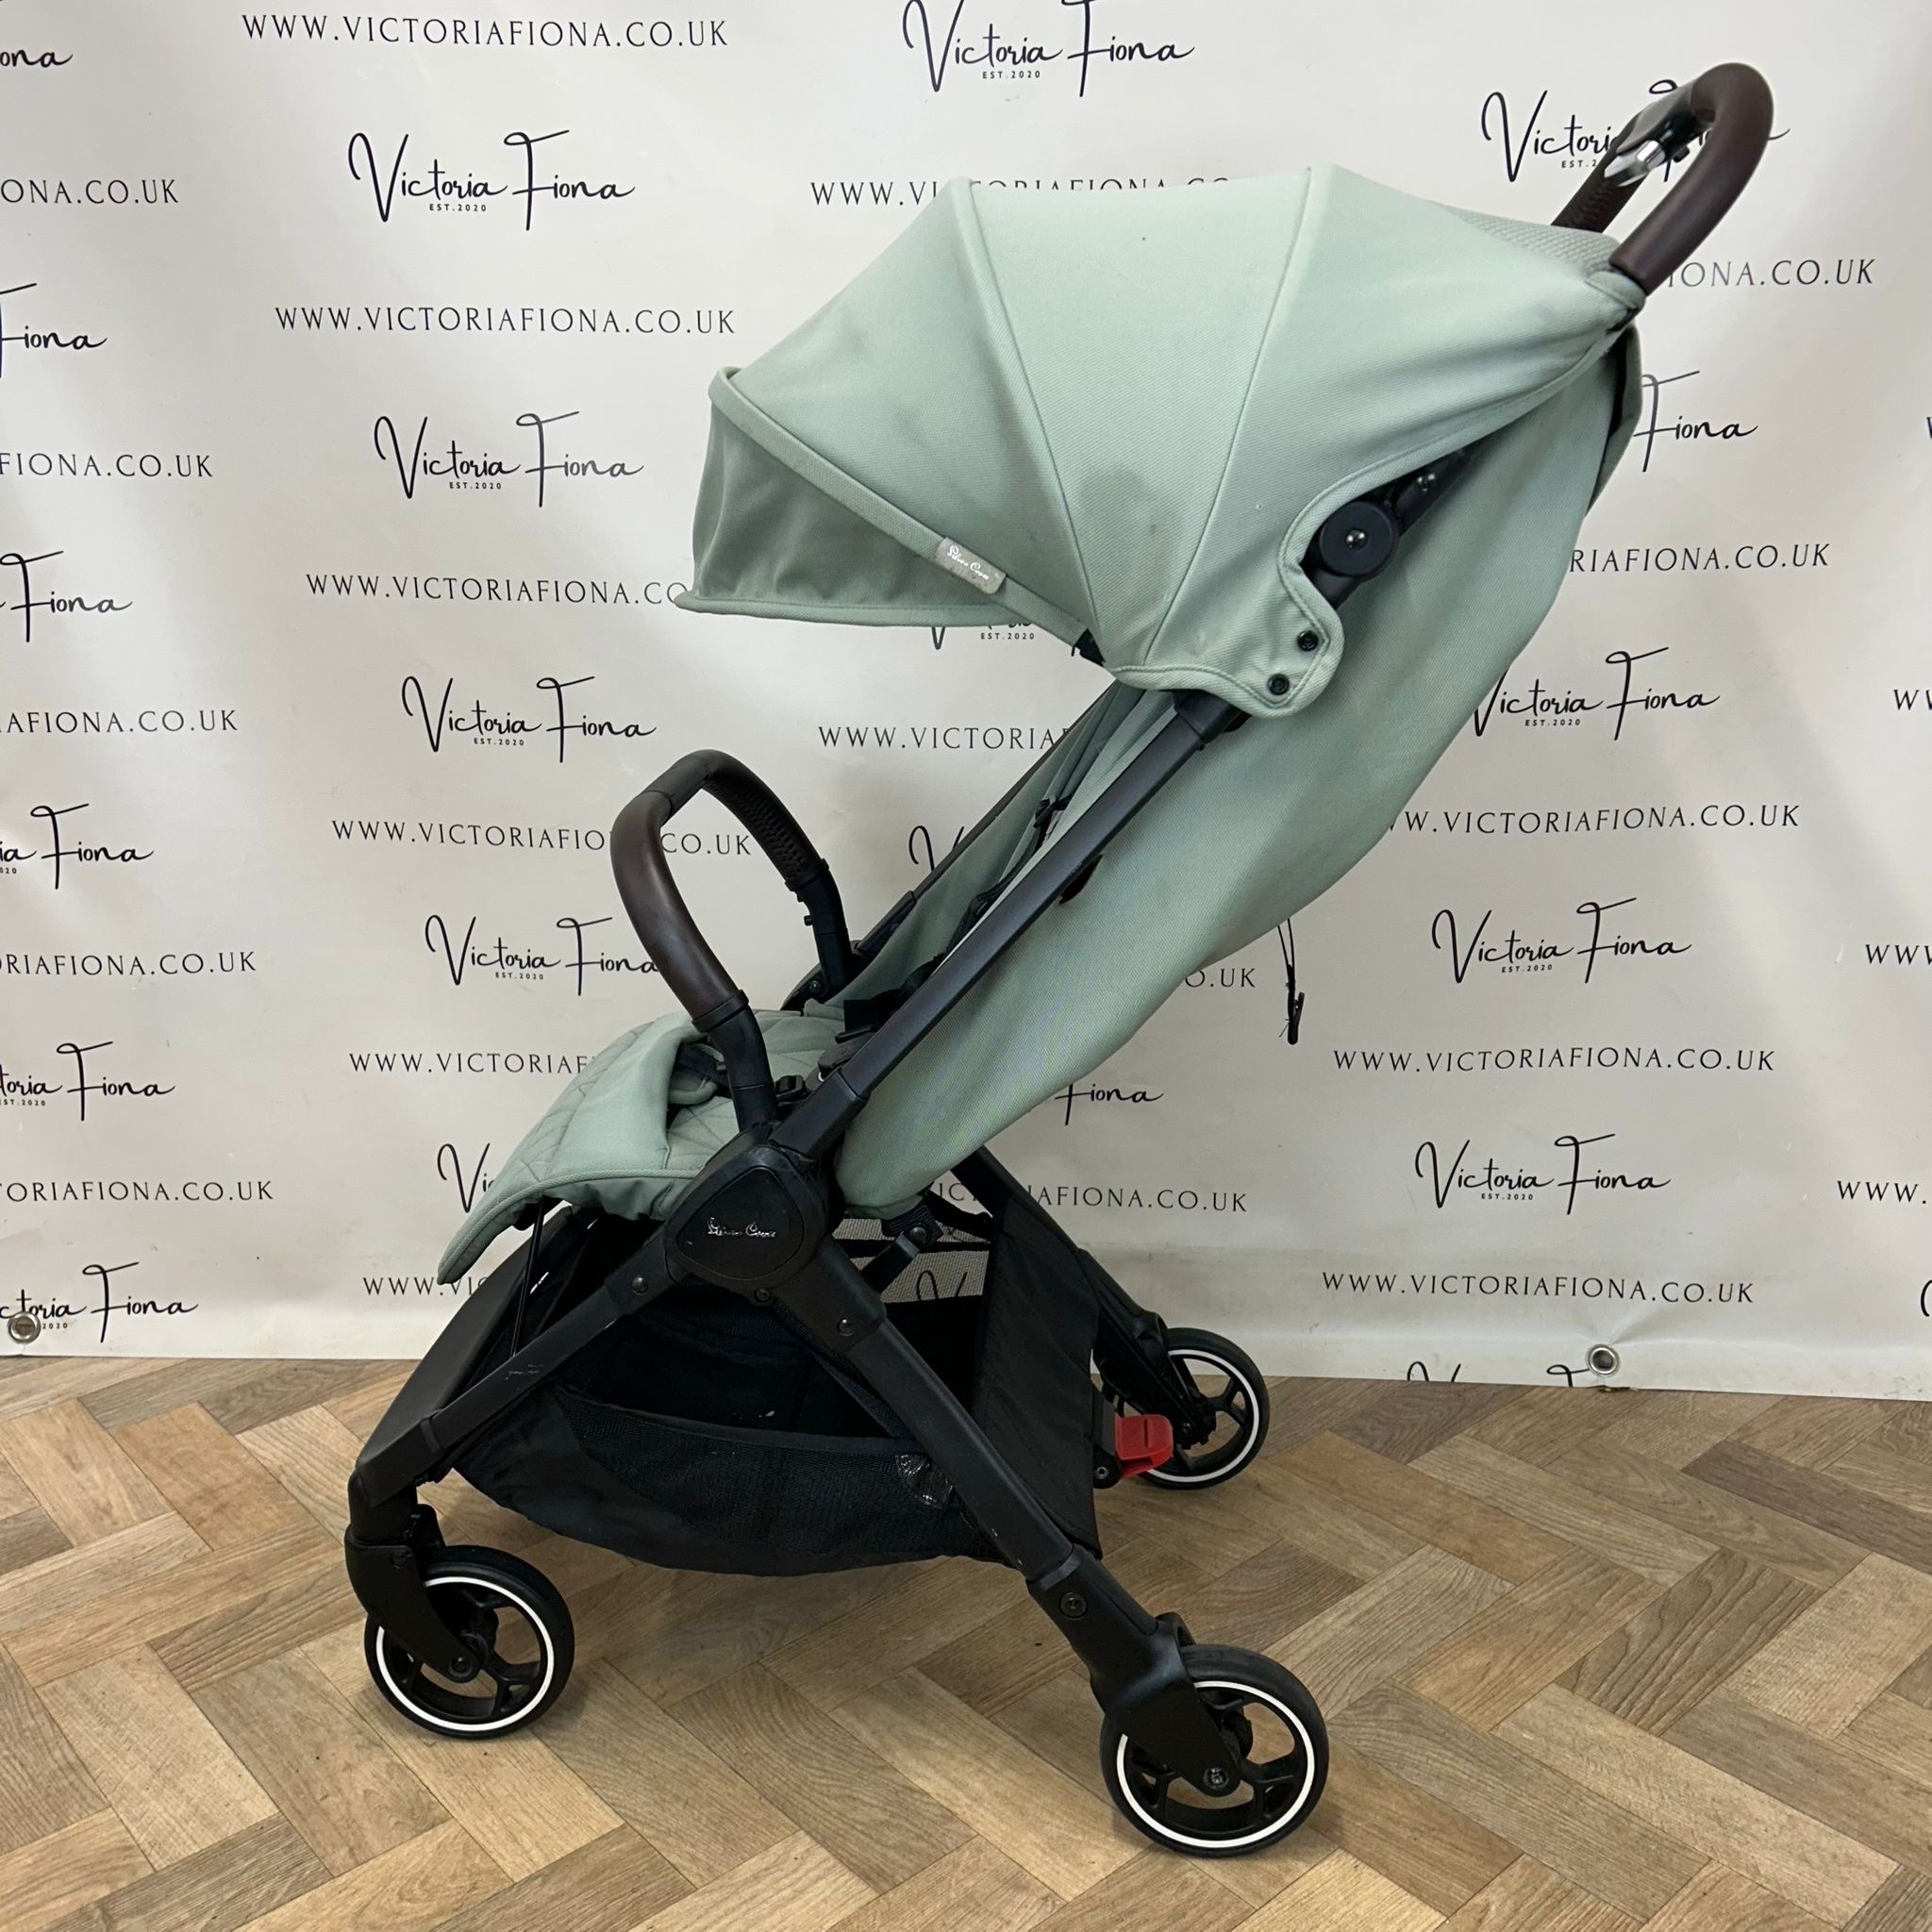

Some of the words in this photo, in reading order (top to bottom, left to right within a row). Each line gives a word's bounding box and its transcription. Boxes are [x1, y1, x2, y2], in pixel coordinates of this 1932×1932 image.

[242, 15, 727, 47] WWW.VICTORIAFIONA.CO.UK
[0, 50, 74, 68] ona
[903, 0, 1063, 92] Victoria
[1061, 0, 1195, 97] Fiona
[983, 71, 1040, 79] EST.2020
[1481, 90, 1611, 182] Victori
[1561, 159, 1595, 168] EST.2
[348, 133, 508, 223] Victoria
[504, 129, 636, 231] Fiona
[275, 307, 735, 333] WWW.VICTORIAFIONA.CO.UK
[1633, 370, 1758, 473] Fiona
[374, 416, 521, 499] Victoria
[516, 411, 644, 508] Fiona
[1570, 543, 1830, 572] RIAFIONA.CO.UK
[0, 551, 133, 642] Fiona
[306, 574, 688, 604] WWW.VICTORIAFIONA.CO
[1605, 646, 1721, 741] Fiona
[0, 710, 238, 733] AFIONA.CO.UK
[402, 675, 542, 753] Victoria
[536, 676, 657, 763] Fiona
[818, 726, 1067, 749] WWW.VICTORIA
[1391, 805, 1799, 834] W.VICTORIAFIONA.CO.UK
[30, 803, 154, 890] Fiona
[425, 915, 561, 986] Victoria
[557, 917, 659, 996] Fiona
[1432, 909, 1574, 984] Victoria
[1576, 897, 1692, 984] Fiona
[0, 951, 256, 975] RIAFIONA.CO.UK
[349, 1053, 596, 1074] WWW.VICTORIAF
[1334, 1047, 1774, 1072] WWW.VICTORIAFIONA.CO.UK
[0, 1064, 63, 1096] toria
[57, 1041, 175, 1122] Fiona
[1415, 1140, 1555, 1208] Victoria
[1554, 1134, 1671, 1215] Fiona
[0, 1181, 274, 1202] ORIAFIONA.CO.UK
[0, 1289, 87, 1319] ctoria
[82, 1261, 199, 1343] Fiona
[1323, 1272, 1753, 1303] WWW.VICTORIAFIONA.CO.UK
